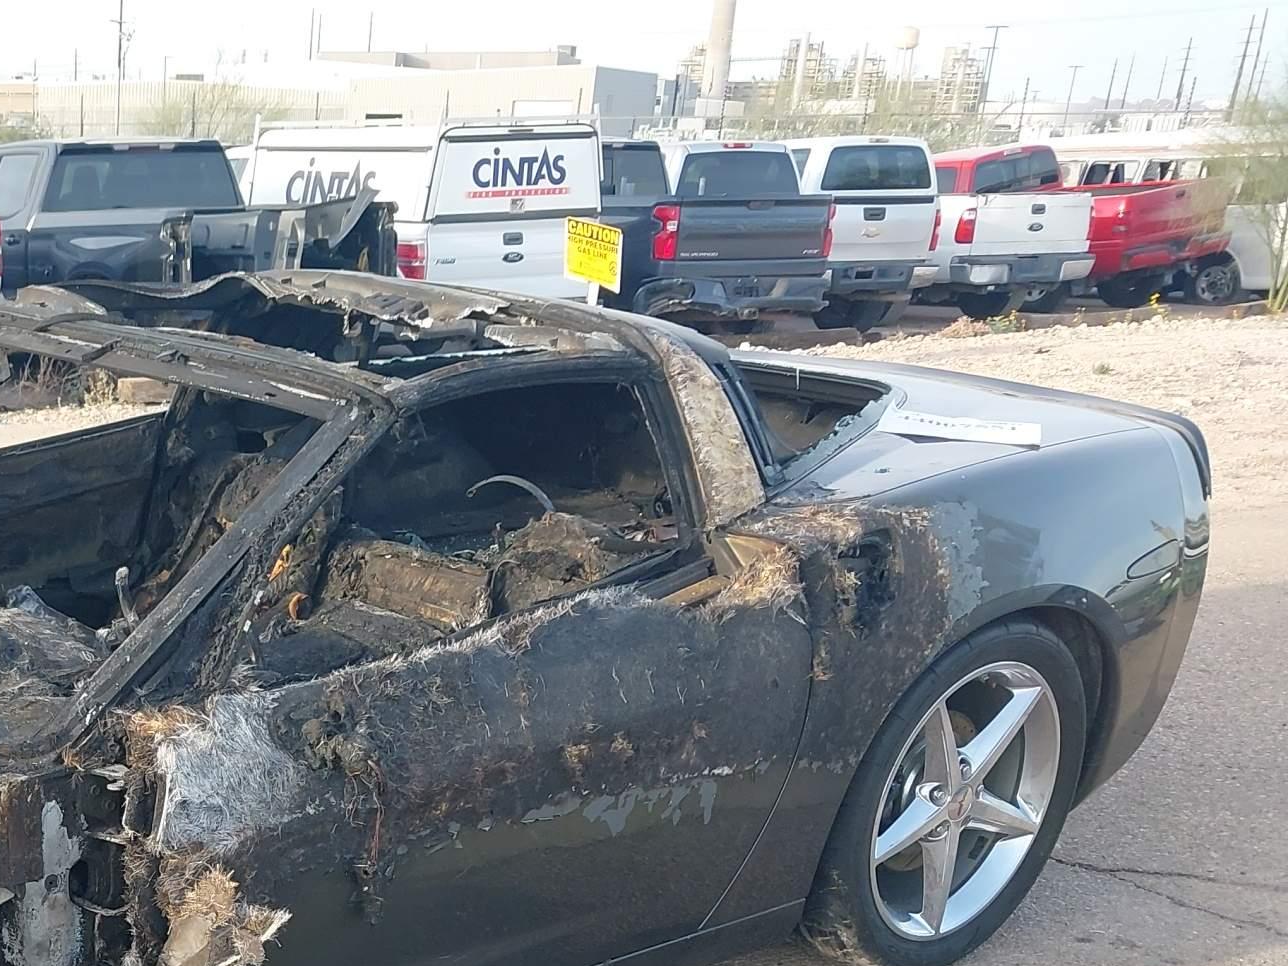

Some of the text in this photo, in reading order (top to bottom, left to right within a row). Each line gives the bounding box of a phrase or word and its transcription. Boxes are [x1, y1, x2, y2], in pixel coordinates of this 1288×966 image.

[568, 220, 619, 245] CAUTION
[577, 246, 607, 259] GAS LINE
